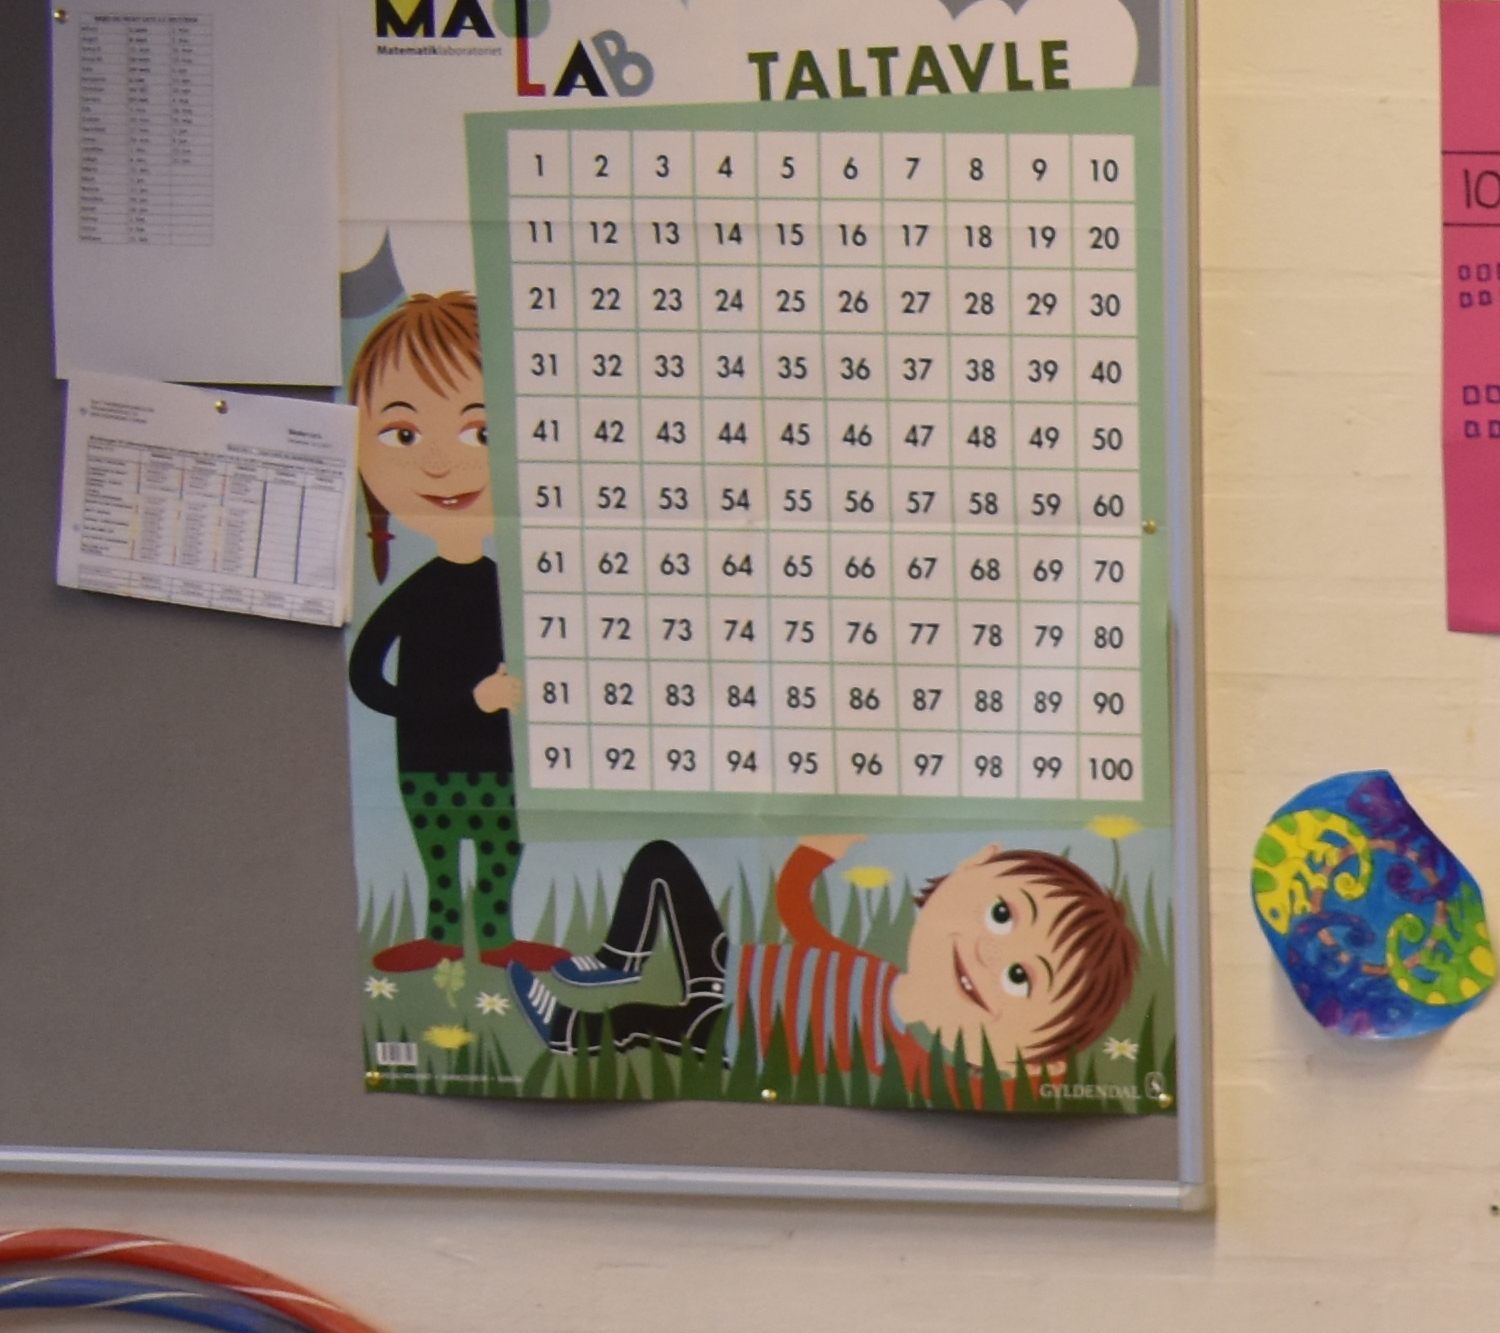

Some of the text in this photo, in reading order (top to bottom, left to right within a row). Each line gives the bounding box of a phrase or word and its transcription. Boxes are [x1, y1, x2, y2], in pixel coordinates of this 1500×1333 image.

[517, 30, 655, 97] LAB
[748, 40, 1070, 101] TALTAVLE
[534, 154, 1119, 183] 1 2 3 4 5 6 7 8 9 10
[527, 220, 1120, 250] 11 12 13 14 15 16 17 18 19 20
[529, 286, 1121, 317] 21 22 23 24 25 26 27 28 29 30
[532, 419, 1123, 451] 41 42 43 44 45 46 47 48 49 50
[537, 550, 1124, 584] 61 62 63 64 65 66 67 68 69 70
[542, 681, 1125, 716] 81 82 83 84 85 86 87 88 89 90
[544, 746, 1134, 782] 91 92 93 94 95 96 97 98 99 100
[1040, 1083, 1141, 1099] GYLDENDAL
